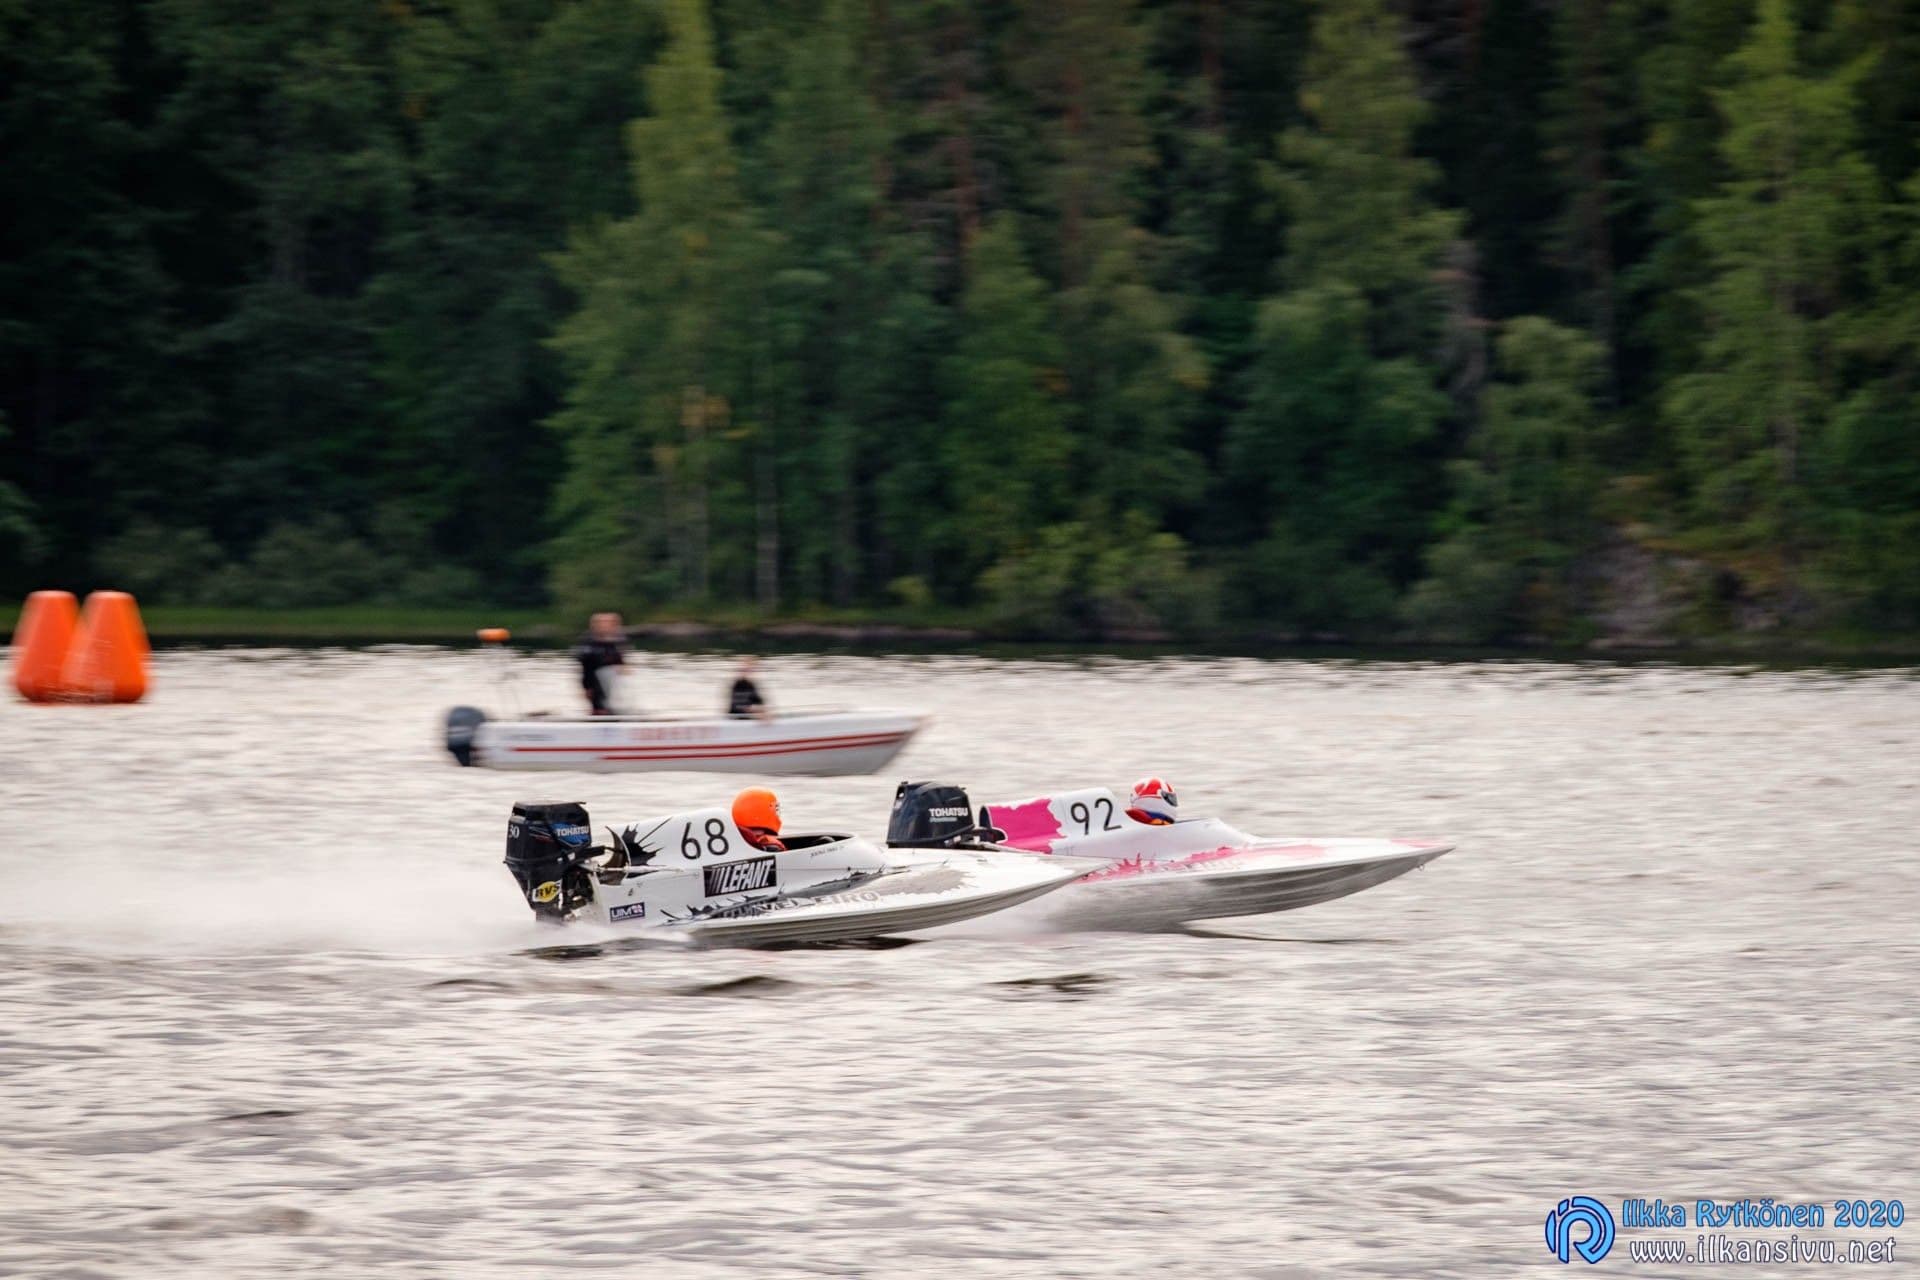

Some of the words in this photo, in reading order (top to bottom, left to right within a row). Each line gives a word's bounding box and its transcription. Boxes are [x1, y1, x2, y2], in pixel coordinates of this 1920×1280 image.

[928, 807, 969, 817] TOHATSU
[1070, 798, 1122, 836] 92
[556, 825, 590, 837] TOHATSU
[681, 818, 729, 860] 68
[611, 907, 633, 919] UIM
